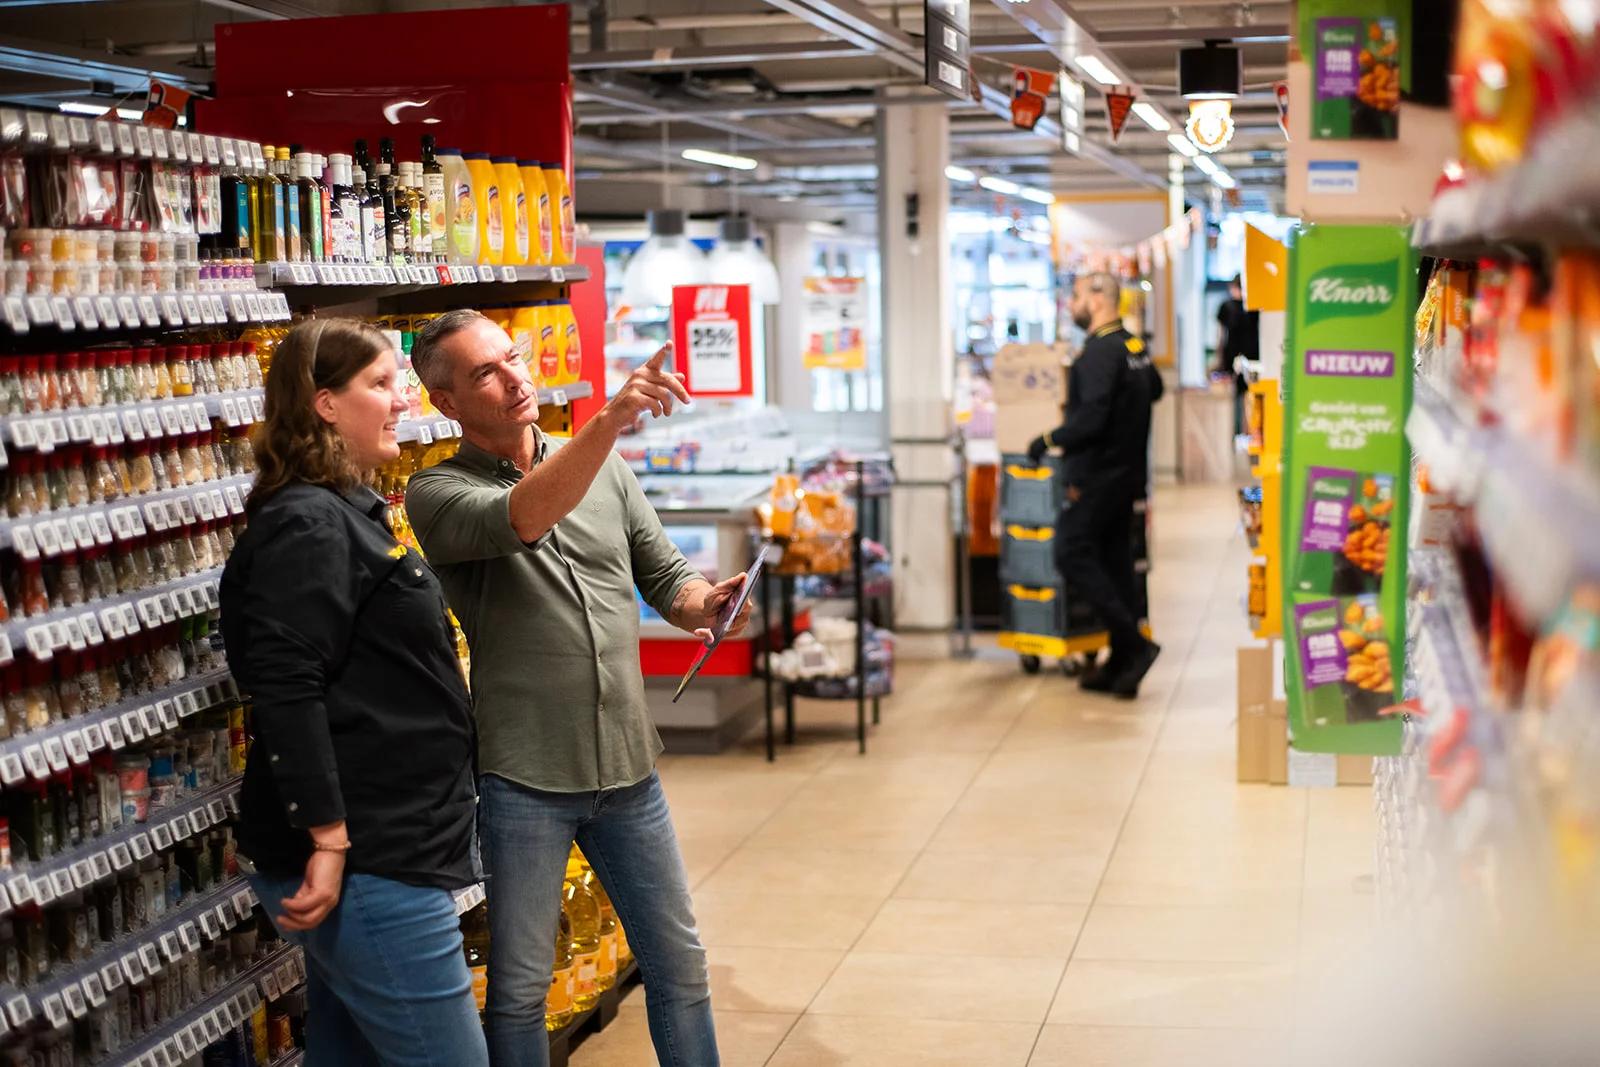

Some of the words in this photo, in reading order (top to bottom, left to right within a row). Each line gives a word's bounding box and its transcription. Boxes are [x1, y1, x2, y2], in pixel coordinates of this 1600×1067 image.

[1309, 277, 1393, 304] Knorr
[692, 327, 735, 347] 25%
[1309, 354, 1390, 374] NIEUW
